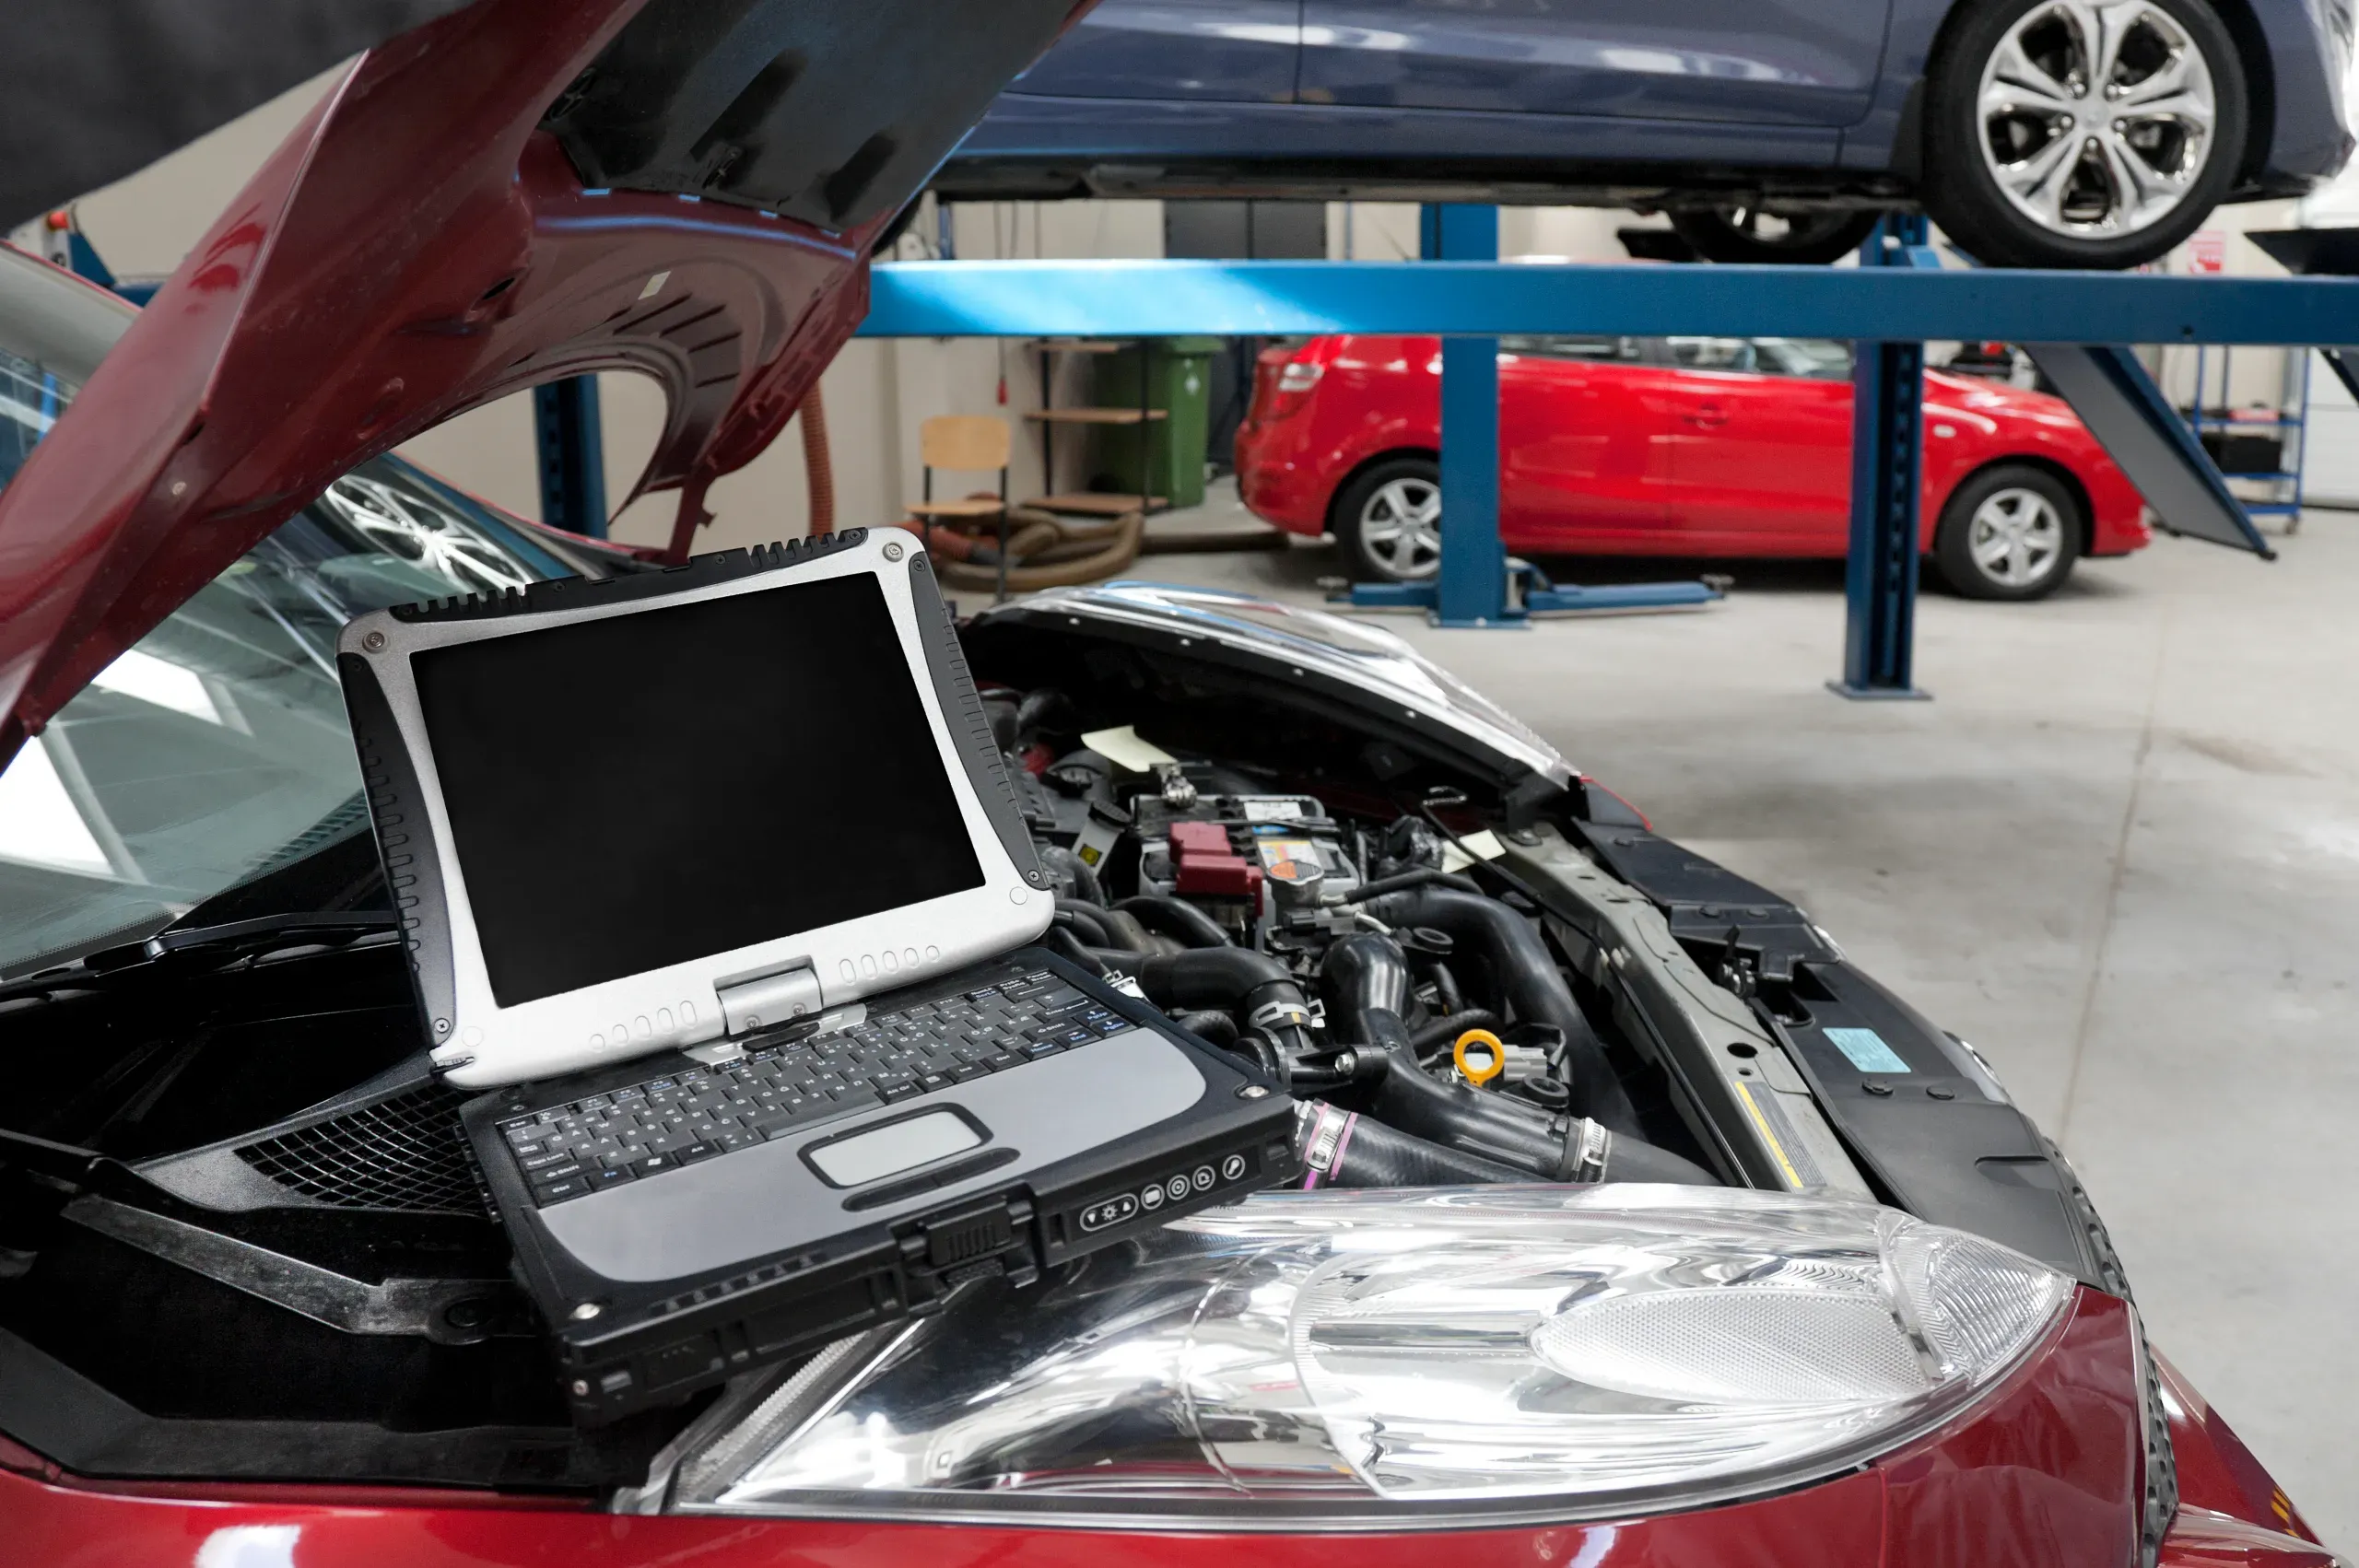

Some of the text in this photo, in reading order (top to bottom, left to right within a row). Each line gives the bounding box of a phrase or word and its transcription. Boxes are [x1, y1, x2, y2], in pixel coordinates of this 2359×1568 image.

[1087, 1012, 1108, 1020] PgUp
[1046, 1023, 1065, 1031] Shift
[1103, 1022, 1124, 1031] PgDn
[1030, 1044, 1053, 1053] Home
[526, 1153, 565, 1166] Caps Lock
[557, 1164, 580, 1175] Shift
[552, 1185, 570, 1193] Ctrl
